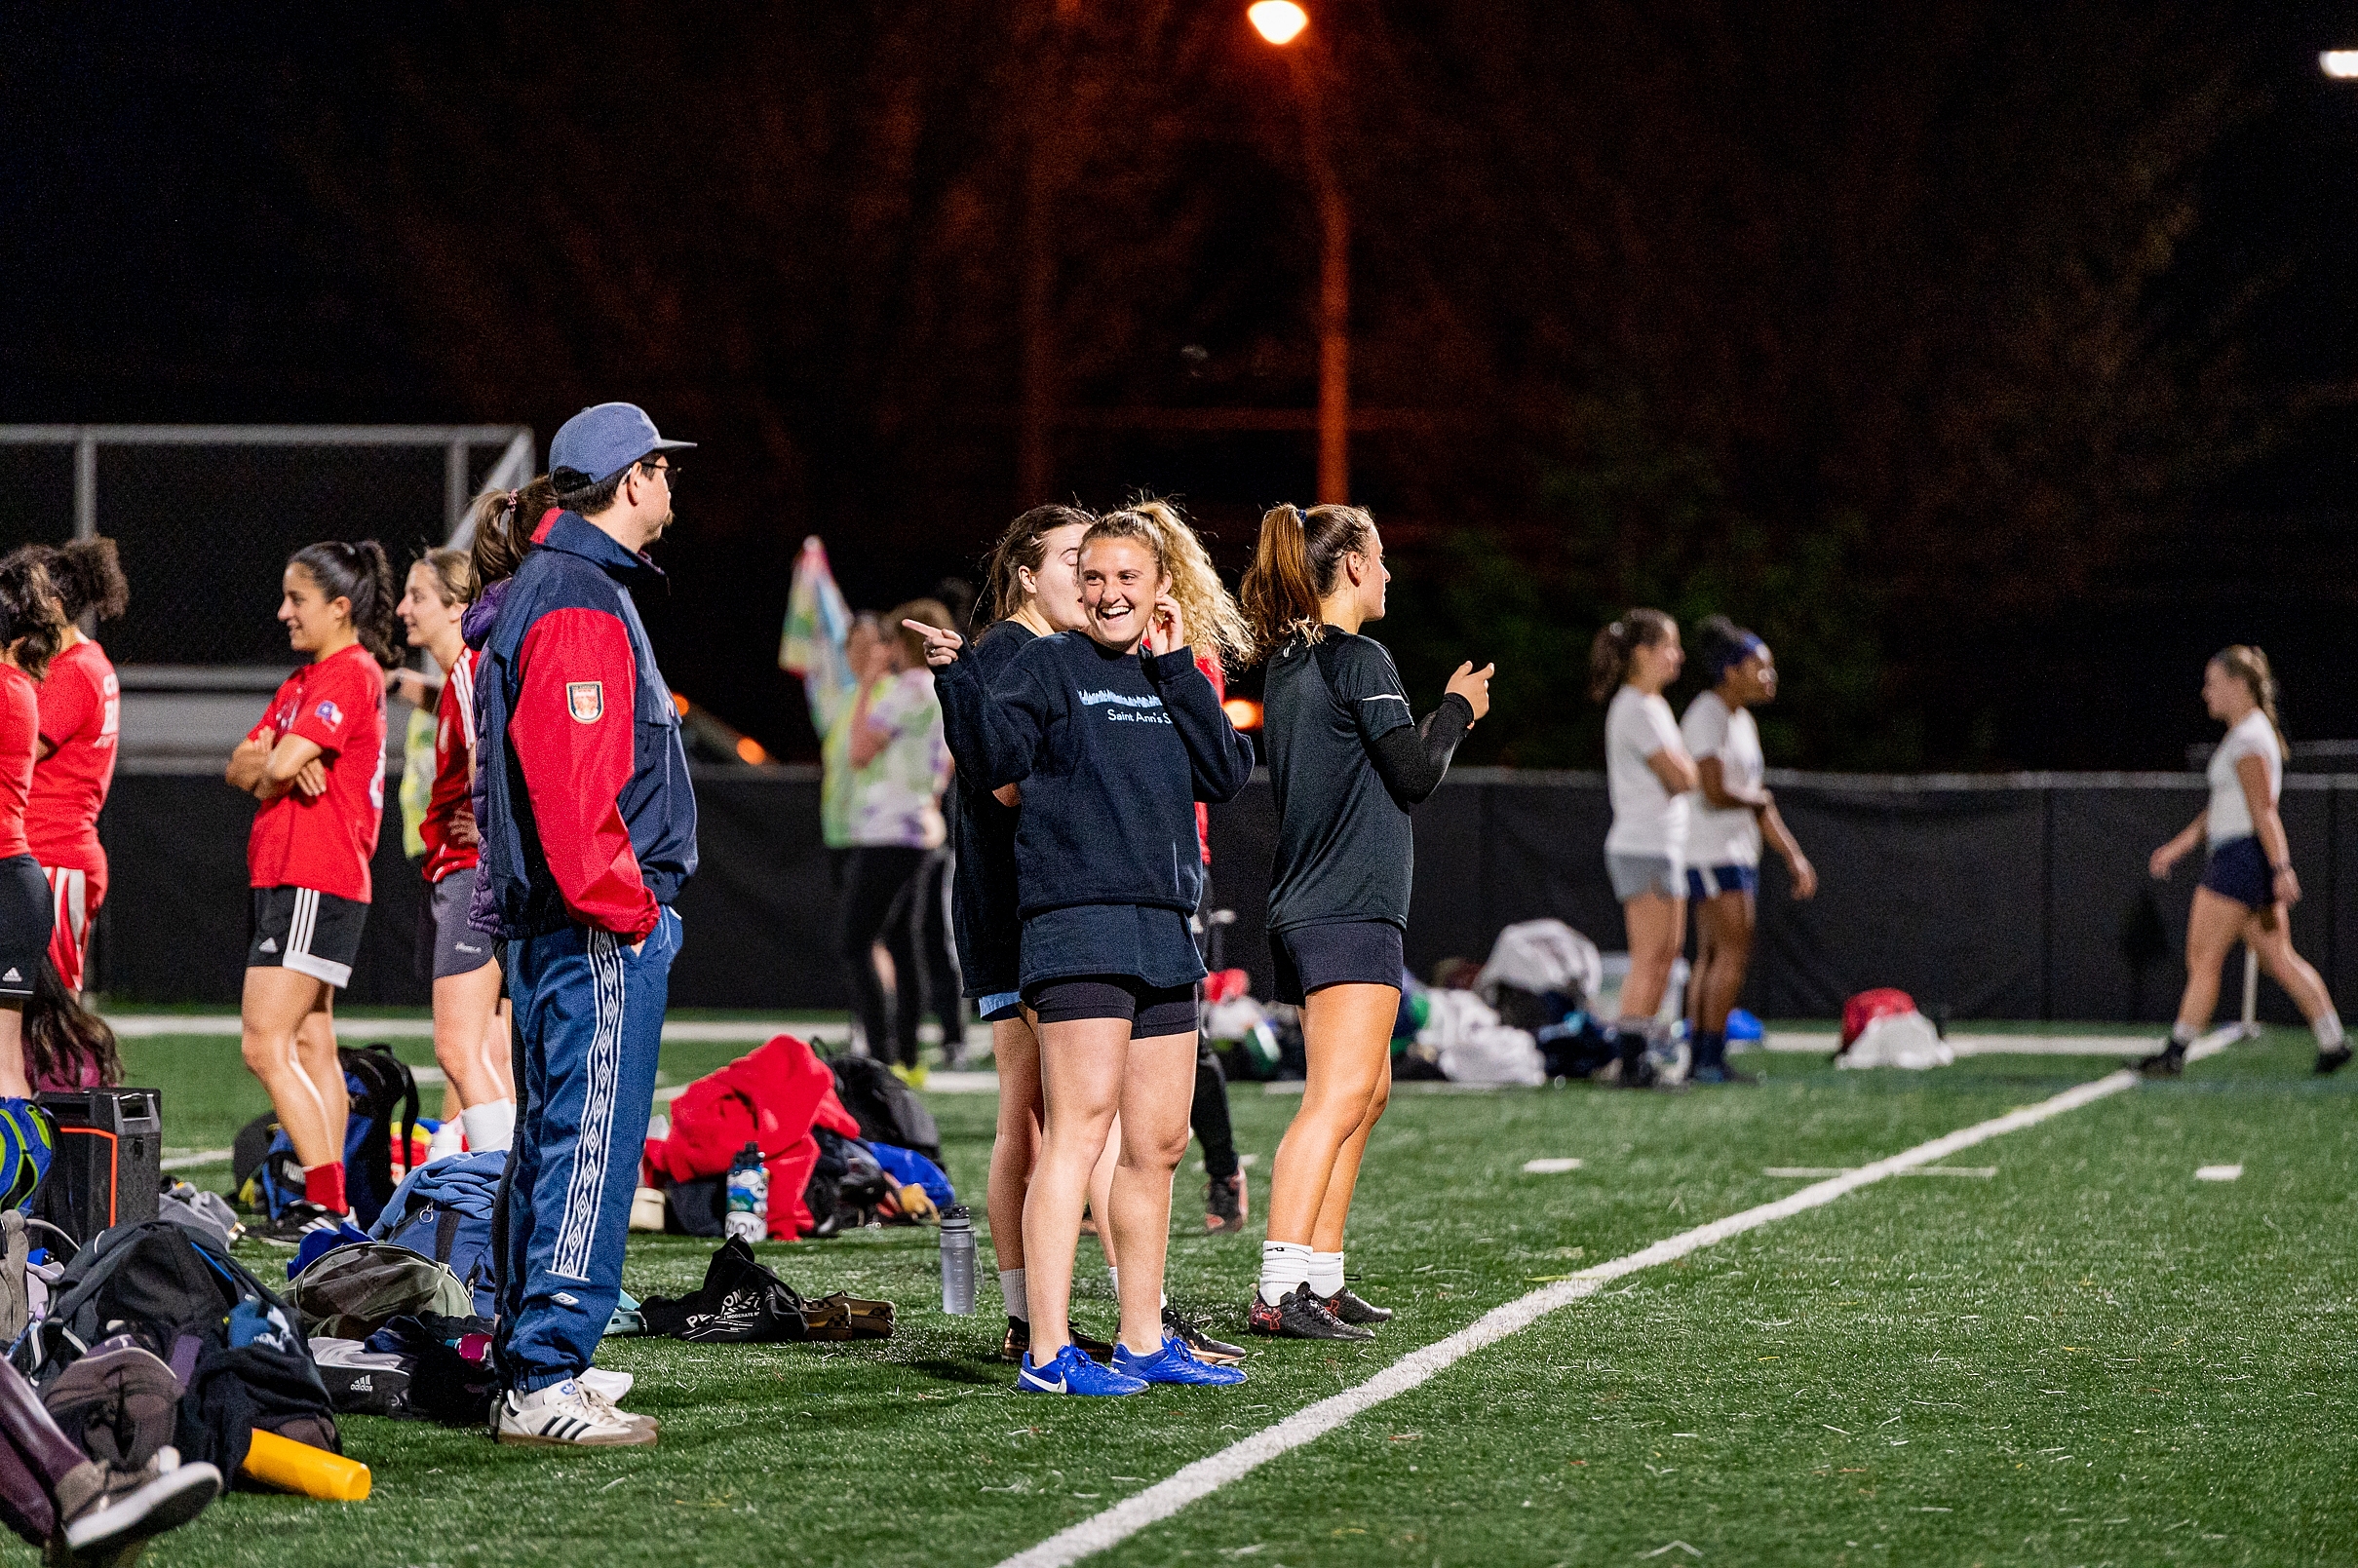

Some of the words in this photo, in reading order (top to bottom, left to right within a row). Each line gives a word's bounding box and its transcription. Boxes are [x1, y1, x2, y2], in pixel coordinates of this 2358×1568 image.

[1107, 708, 1134, 721] Saint
[1137, 711, 1163, 723] Ann's
[350, 1383, 373, 1392] adidas
